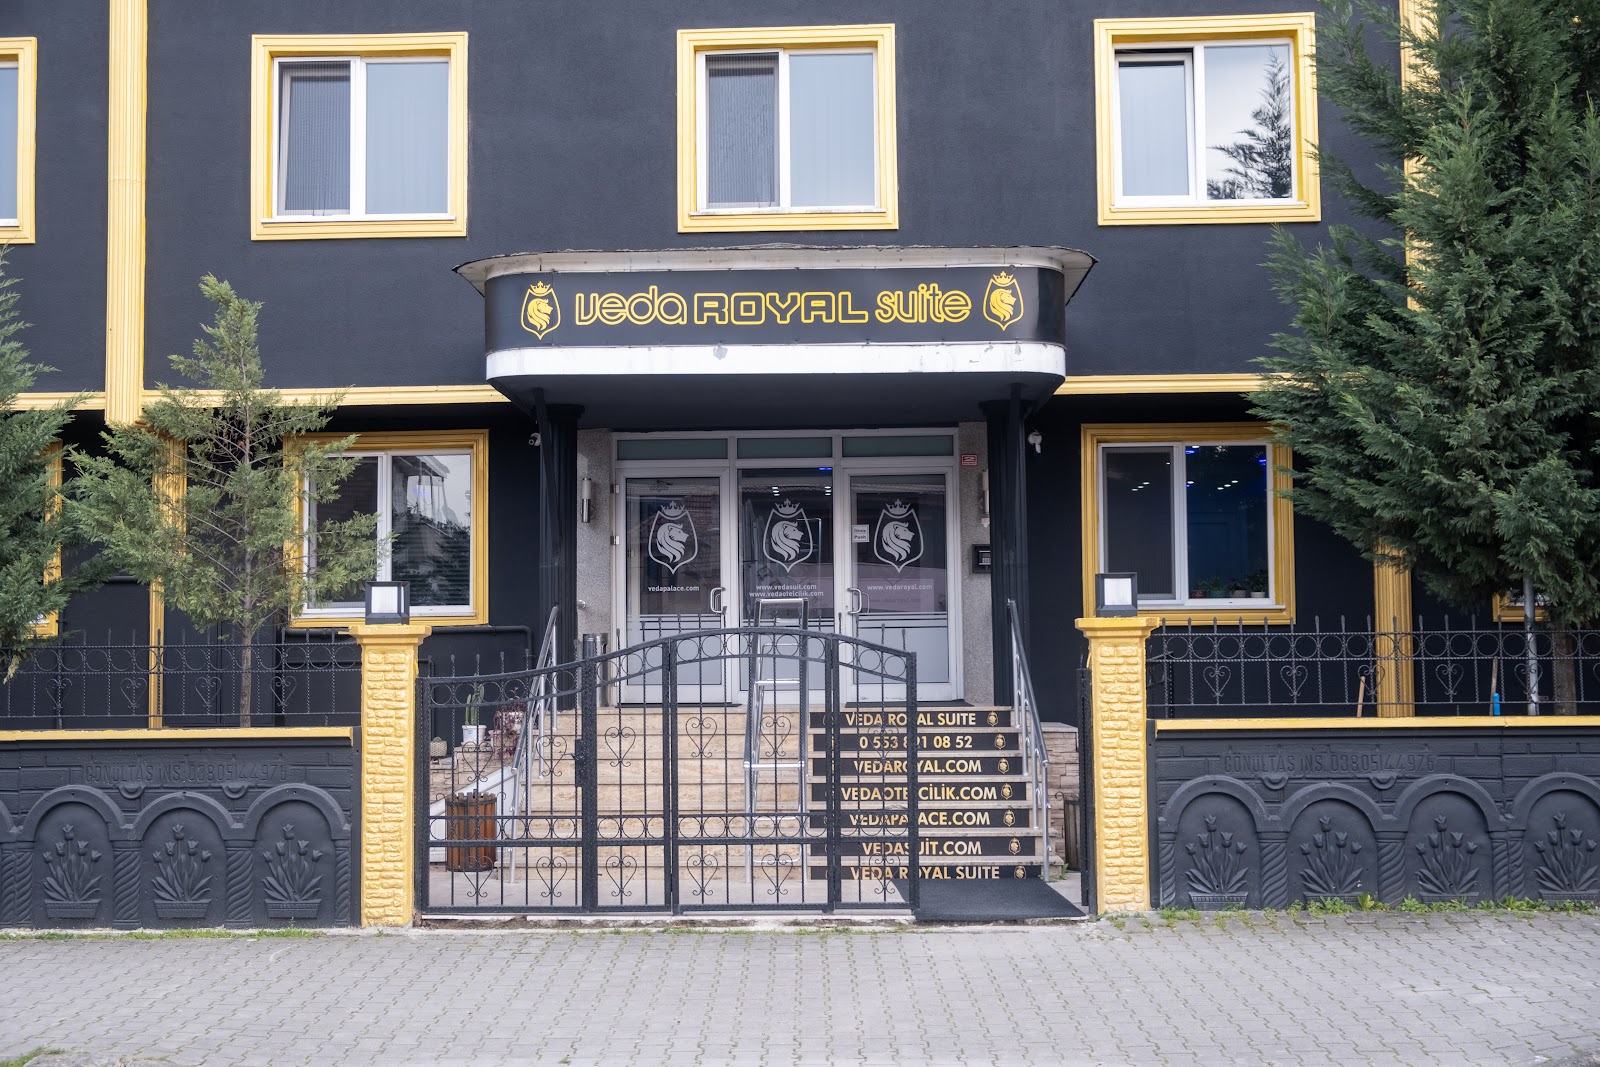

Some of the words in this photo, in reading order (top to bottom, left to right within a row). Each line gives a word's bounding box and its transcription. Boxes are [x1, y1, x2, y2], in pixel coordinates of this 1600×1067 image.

[576, 285, 687, 325] veda
[694, 292, 868, 325] ROYAL
[875, 283, 972, 323] suite
[647, 585, 700, 593] vedapalace.com
[867, 584, 933, 592] www.vedaroyal.com
[845, 712, 883, 727] VEDA
[888, 711, 934, 727] ROAL
[937, 711, 976, 726] SUITE
[860, 736, 869, 750] 0
[873, 736, 899, 749] 553
[933, 736, 951, 749] 08
[955, 736, 973, 749] 52
[841, 784, 997, 800] VEDAOTECİLİK.COM
[849, 812, 991, 826] VEDAPAACE.COM
[850, 867, 893, 880] VEDA
[899, 867, 951, 880] RYAL
[956, 866, 1000, 879] SUITE
